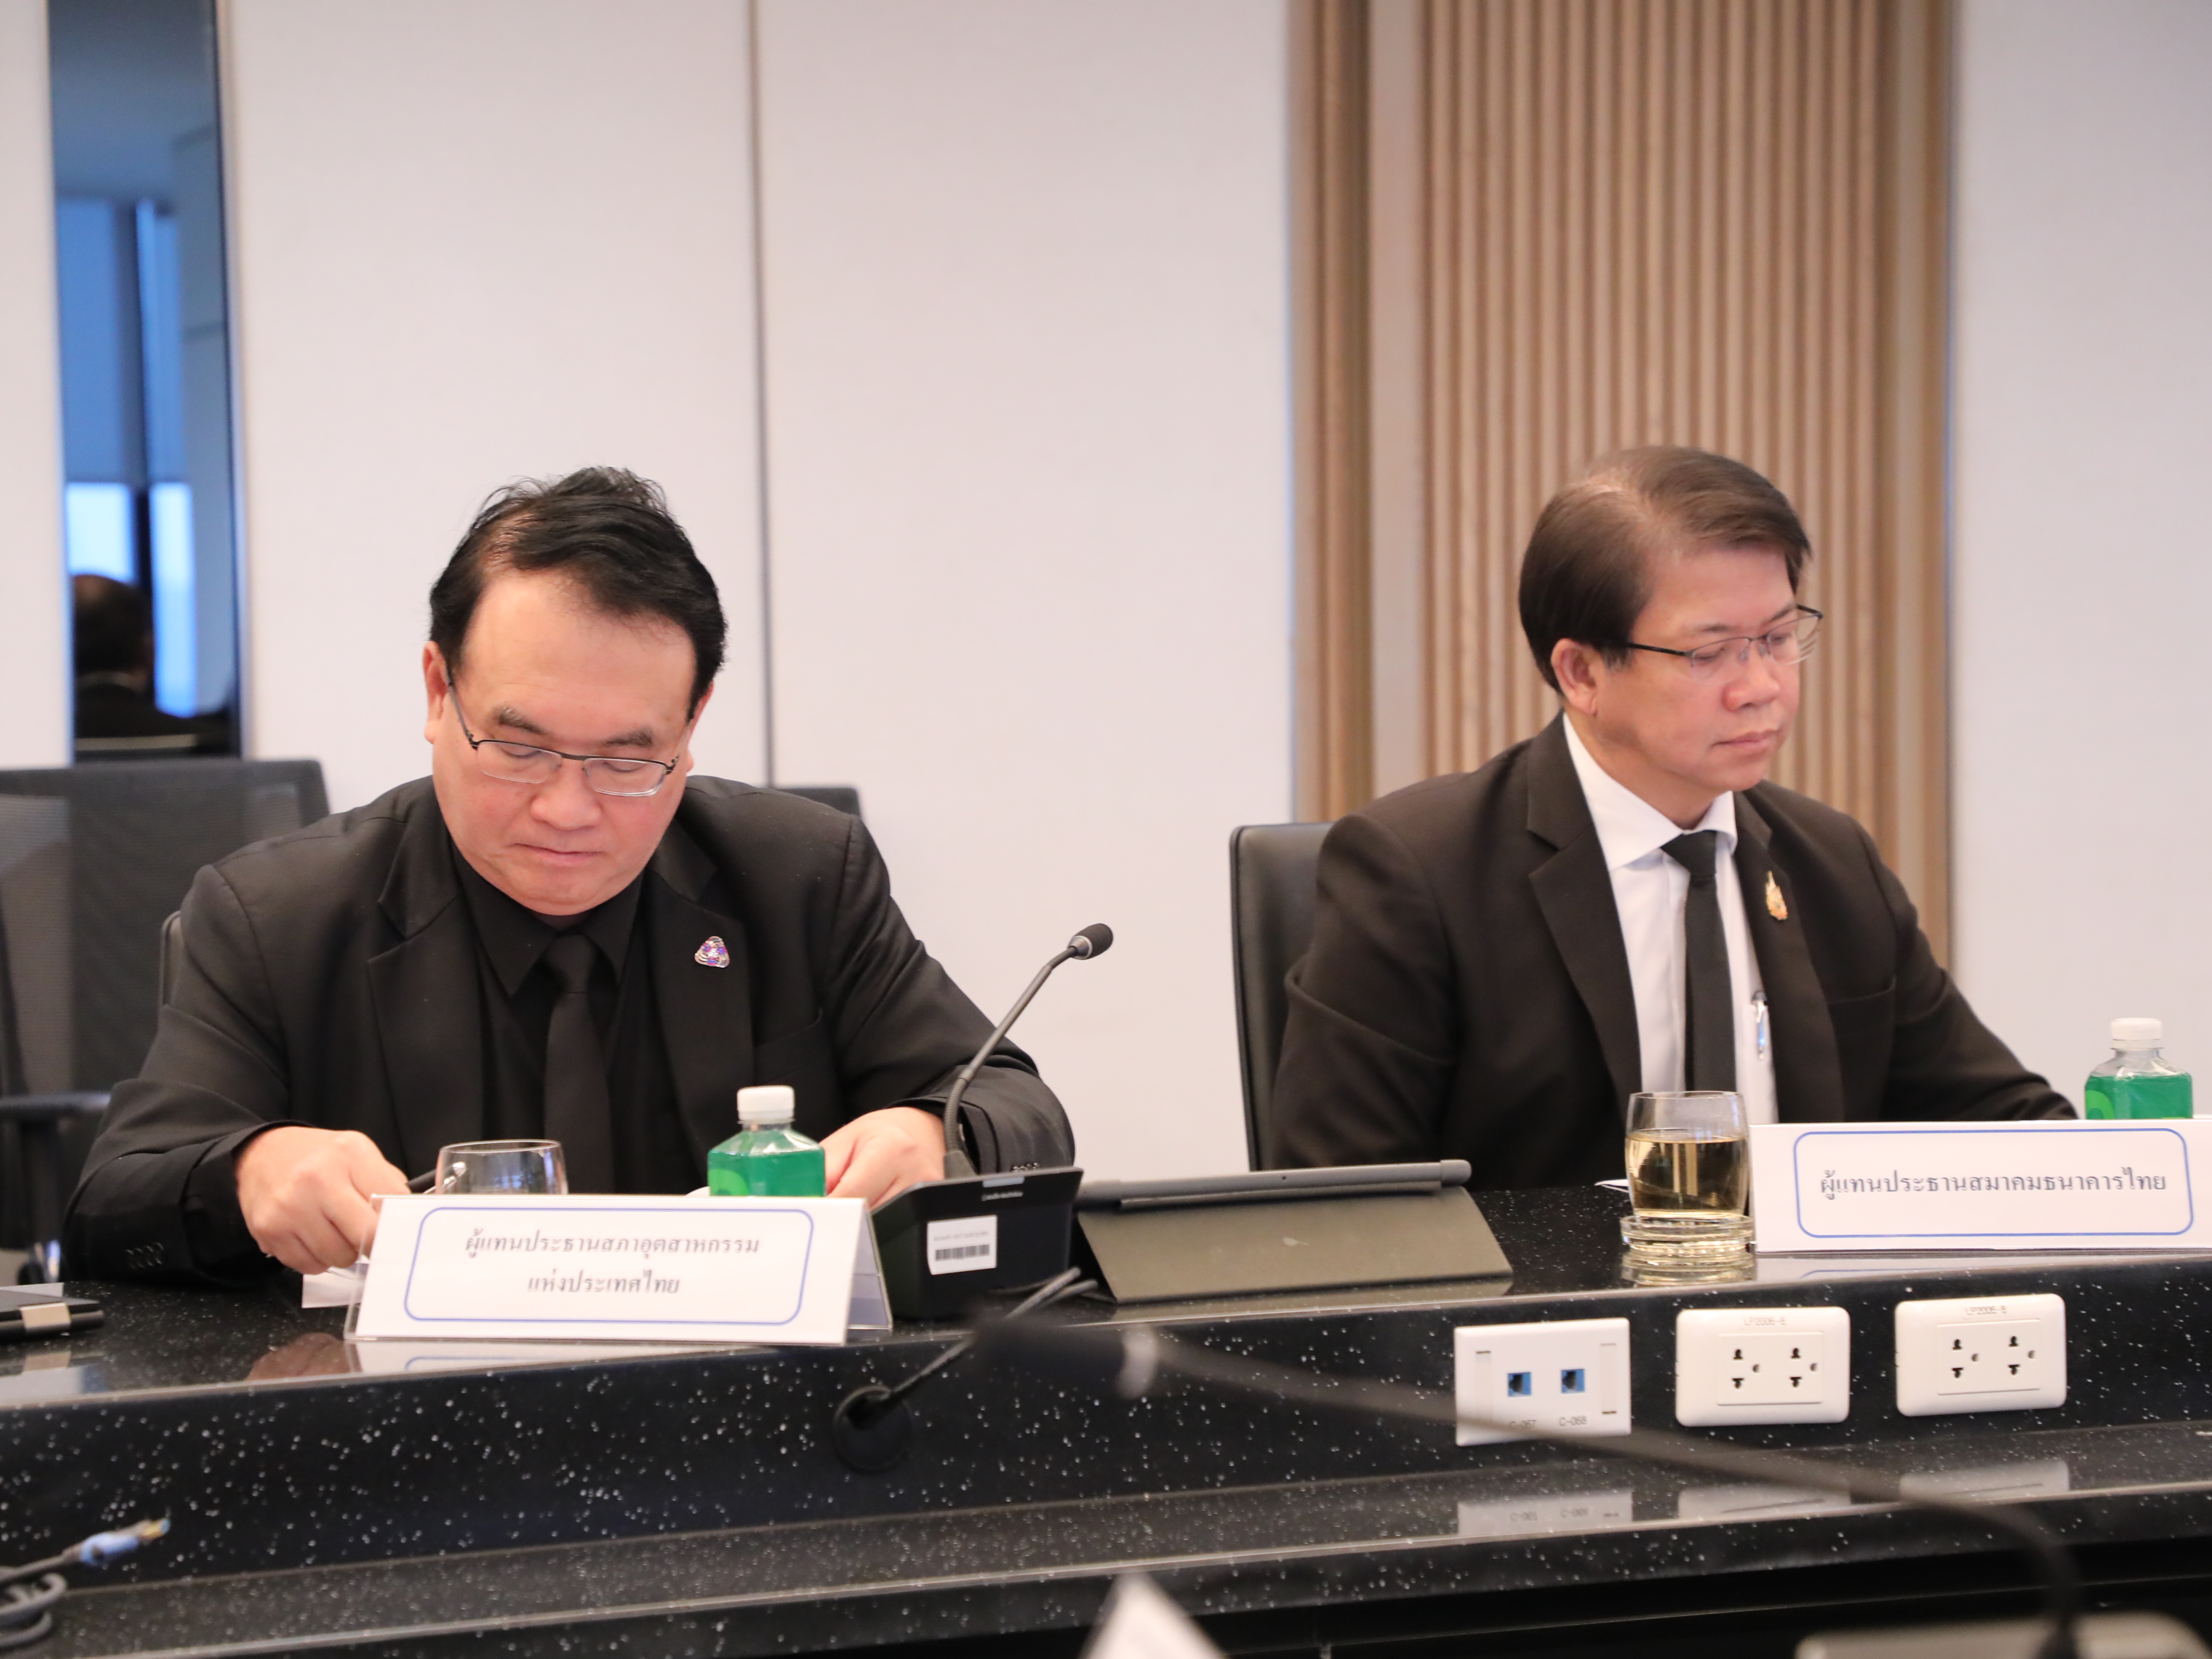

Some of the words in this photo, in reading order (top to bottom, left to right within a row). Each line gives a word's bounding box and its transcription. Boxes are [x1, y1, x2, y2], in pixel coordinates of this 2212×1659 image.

[1821, 1167, 2166, 1200] ผู้แทนประธานสมาคมธนาคารไทย
[465, 1228, 760, 1259] ผู้แทนประธานสภาอุตสาหกรรม
[527, 1268, 680, 1293] แห่งประเทศไทย
